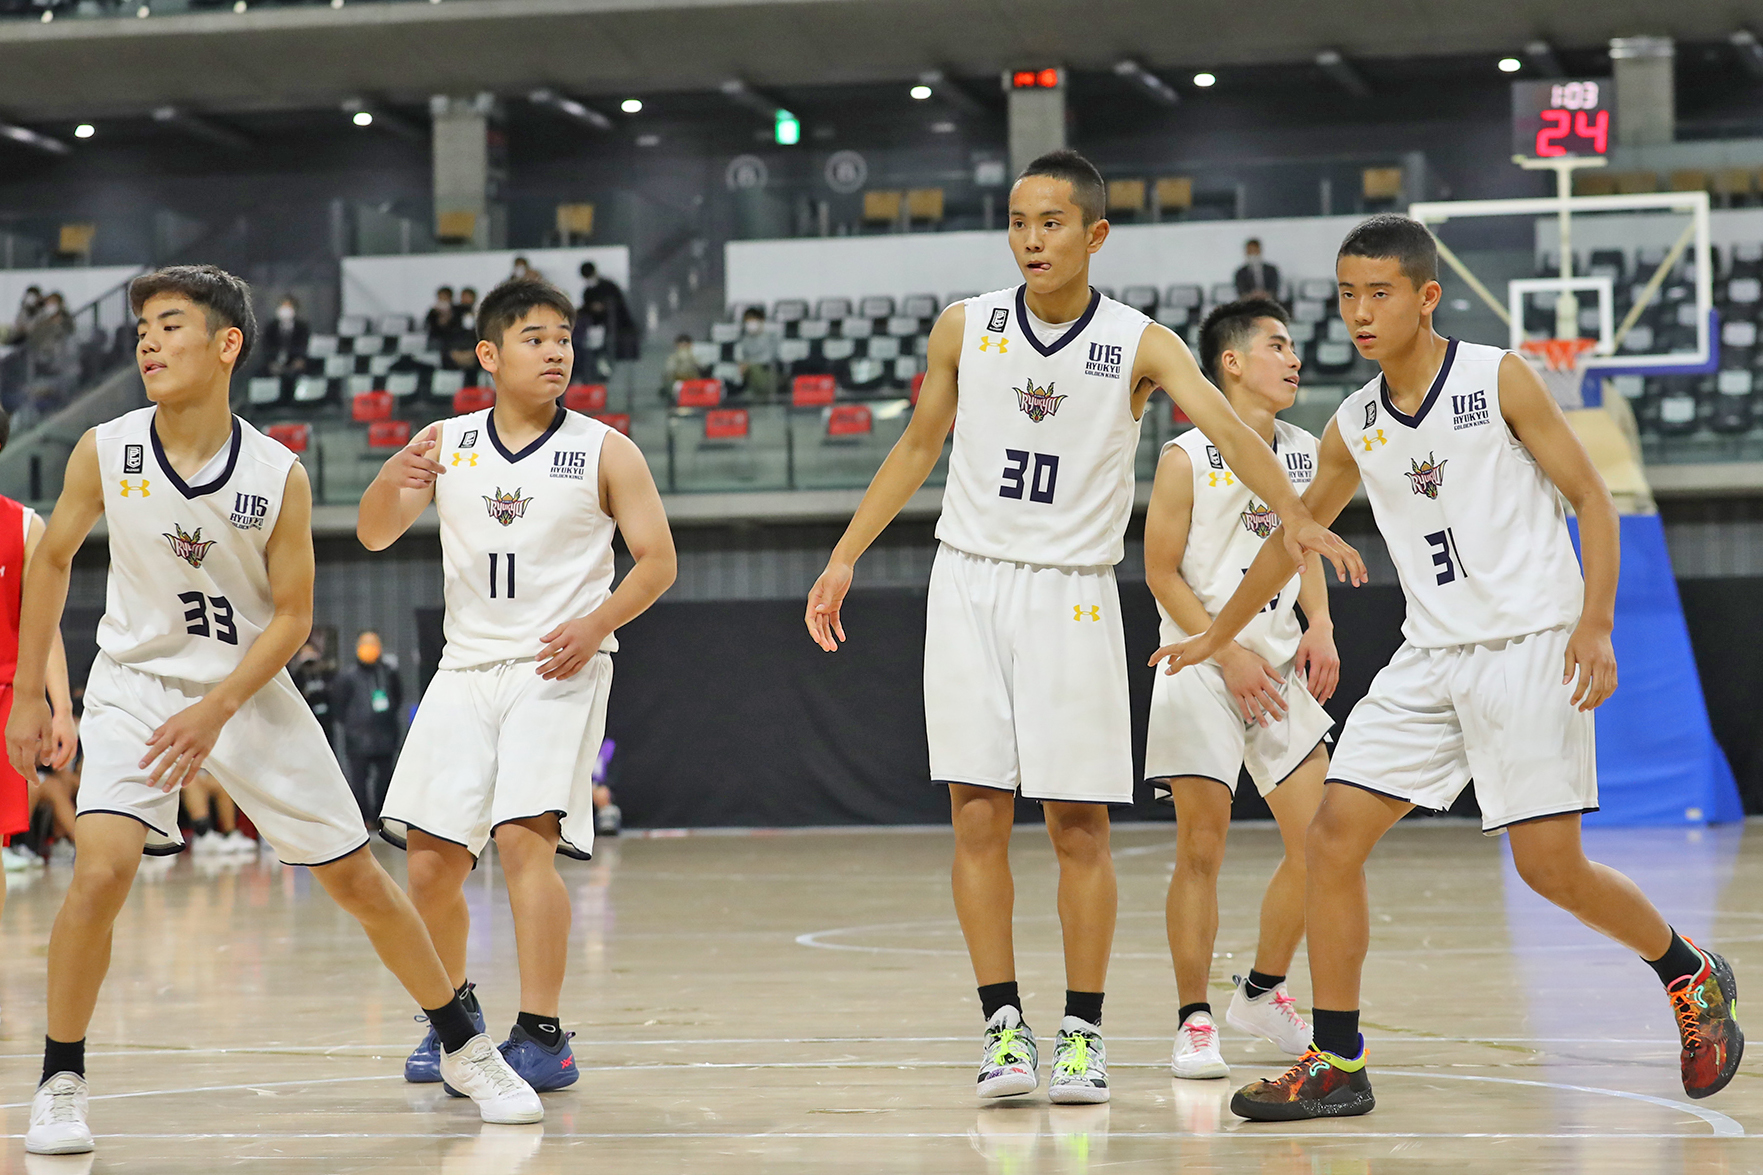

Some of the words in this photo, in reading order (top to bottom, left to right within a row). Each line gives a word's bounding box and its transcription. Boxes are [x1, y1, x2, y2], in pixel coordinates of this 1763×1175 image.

[1535, 109, 1609, 157] 24
[1089, 341, 1122, 365] U15
[1085, 361, 1121, 374] RYUKYU
[1451, 389, 1487, 415] U15
[1453, 410, 1489, 425] RYUKYU
[550, 466, 585, 475] RYUKYU
[553, 450, 587, 468] U15
[1285, 452, 1313, 471] U15
[998, 448, 1060, 504] 30
[235, 490, 269, 517] U15
[1423, 526, 1469, 587] 31
[488, 552, 516, 599] 11
[177, 591, 239, 646] 33
